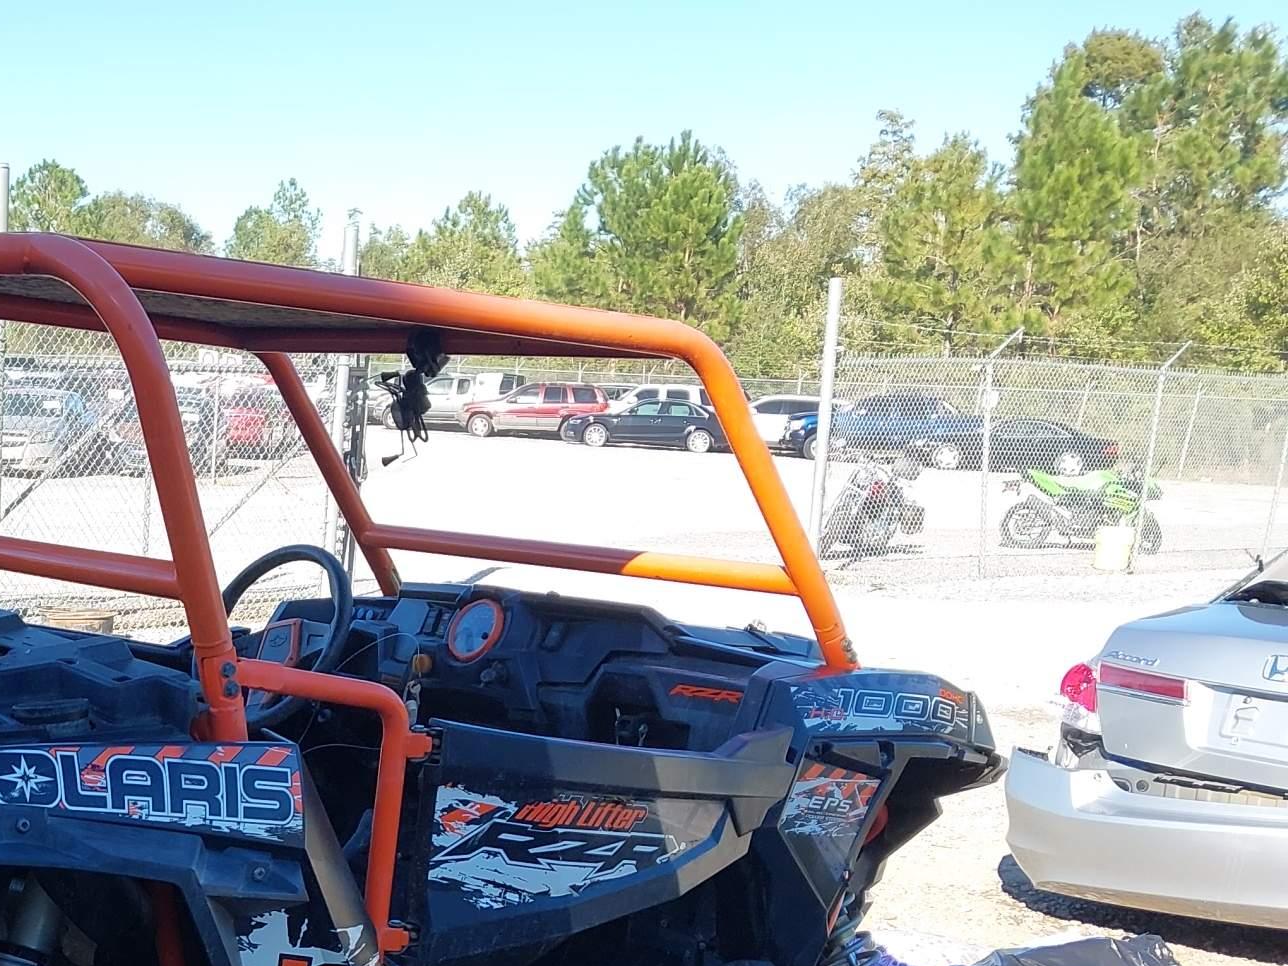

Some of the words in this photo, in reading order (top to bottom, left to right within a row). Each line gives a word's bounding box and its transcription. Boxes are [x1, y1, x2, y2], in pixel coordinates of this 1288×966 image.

[1103, 650, 1160, 667] Accord
[669, 683, 745, 704] RZR
[837, 687, 957, 727] 1000
[808, 795, 853, 813] EPS
[515, 799, 577, 829] High
[579, 800, 649, 832] Lifter
